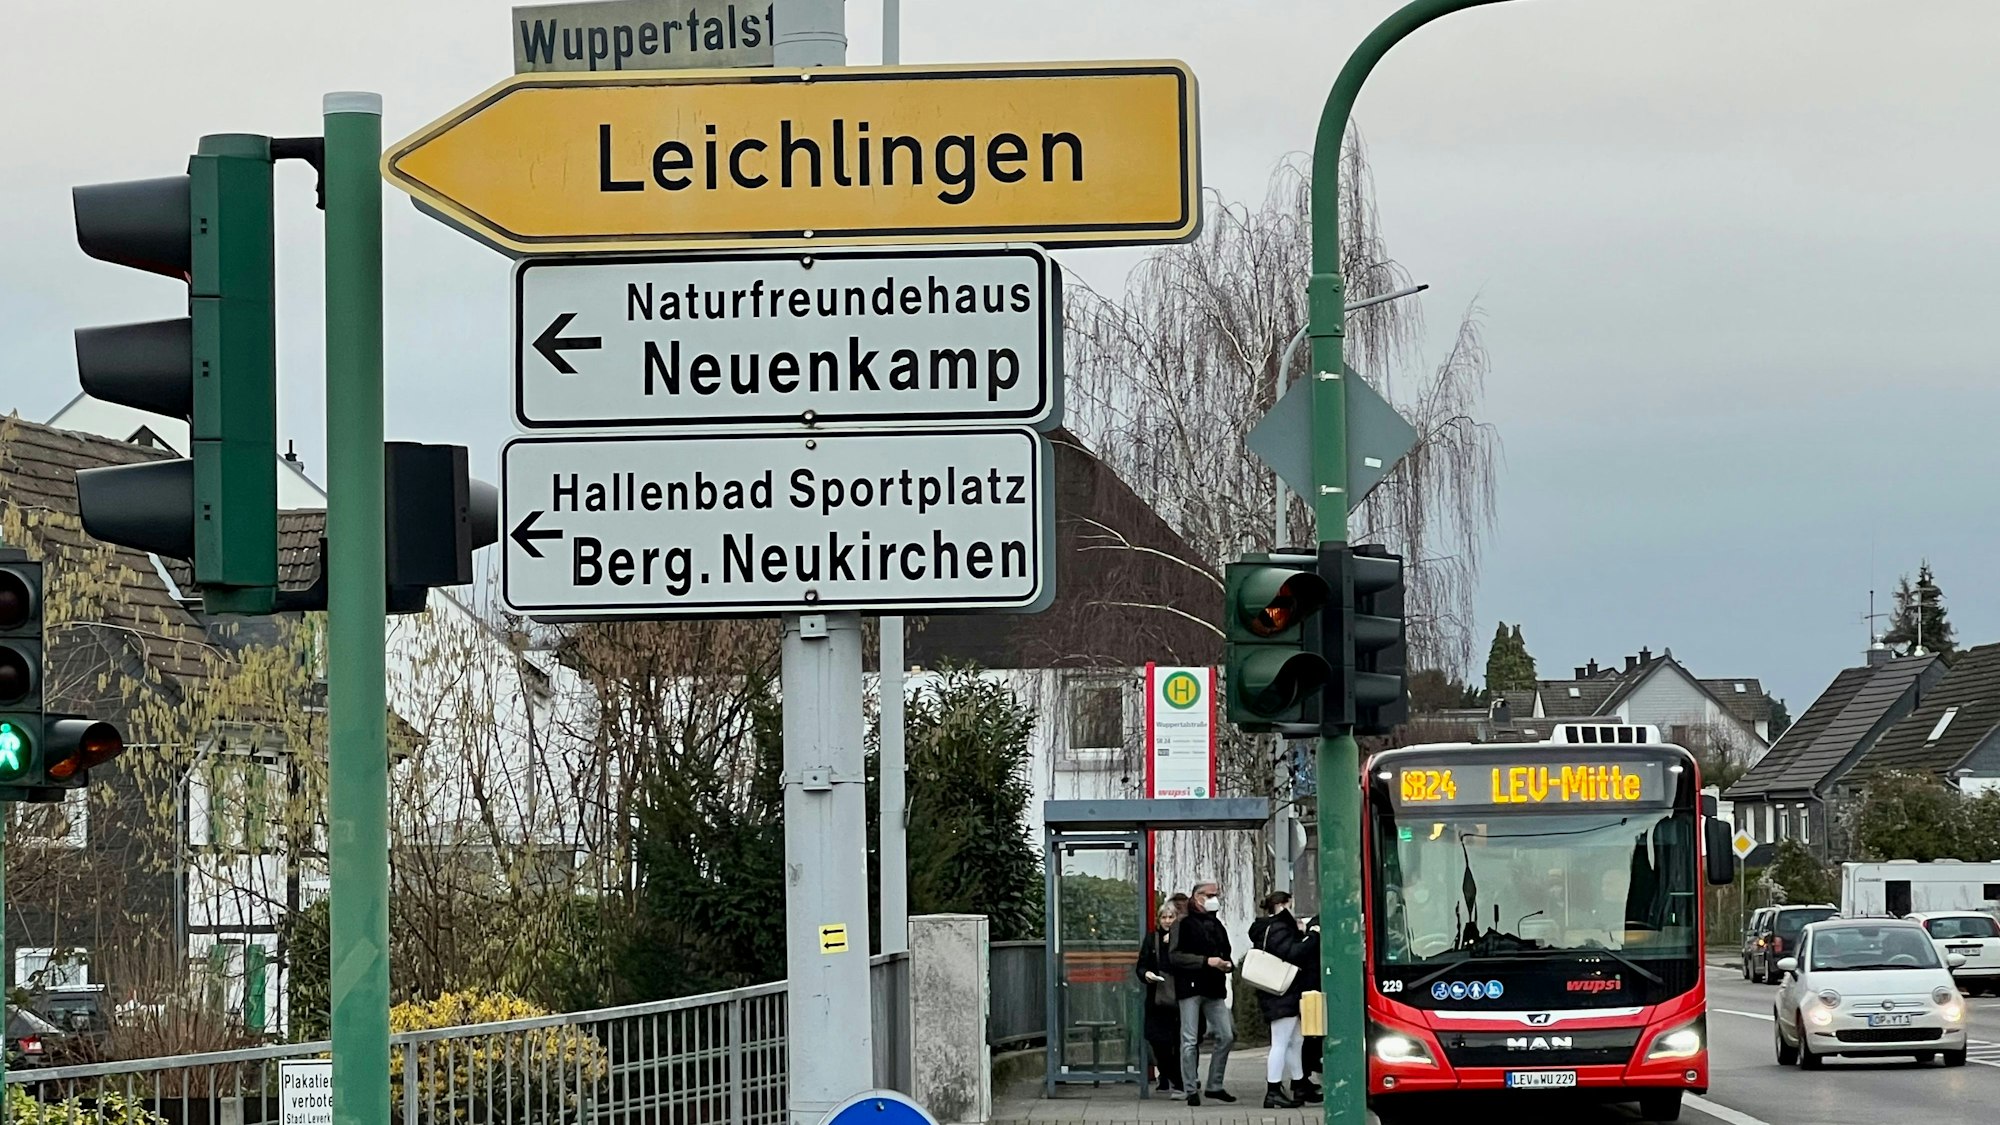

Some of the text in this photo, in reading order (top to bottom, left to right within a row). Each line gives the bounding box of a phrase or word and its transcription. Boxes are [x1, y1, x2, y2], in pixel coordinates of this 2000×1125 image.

[600, 119, 1082, 204] Leichlingen
[628, 276, 1030, 321] Naturfreundehaus
[644, 336, 1019, 401] Neuenkamp
[553, 467, 1026, 515] Hallenbad Sportplatz
[1156, 720, 1208, 728] Wuppertalstraße
[1158, 786, 1191, 798] wupsi
[1491, 765, 1640, 803] LEV-Mitte
[1382, 980, 1403, 993] 229
[1566, 974, 1622, 993] wupsi
[1507, 1036, 1573, 1051] MAN
[1513, 1074, 1533, 1085] LEV
[286, 1113, 306, 1124] Stadt
